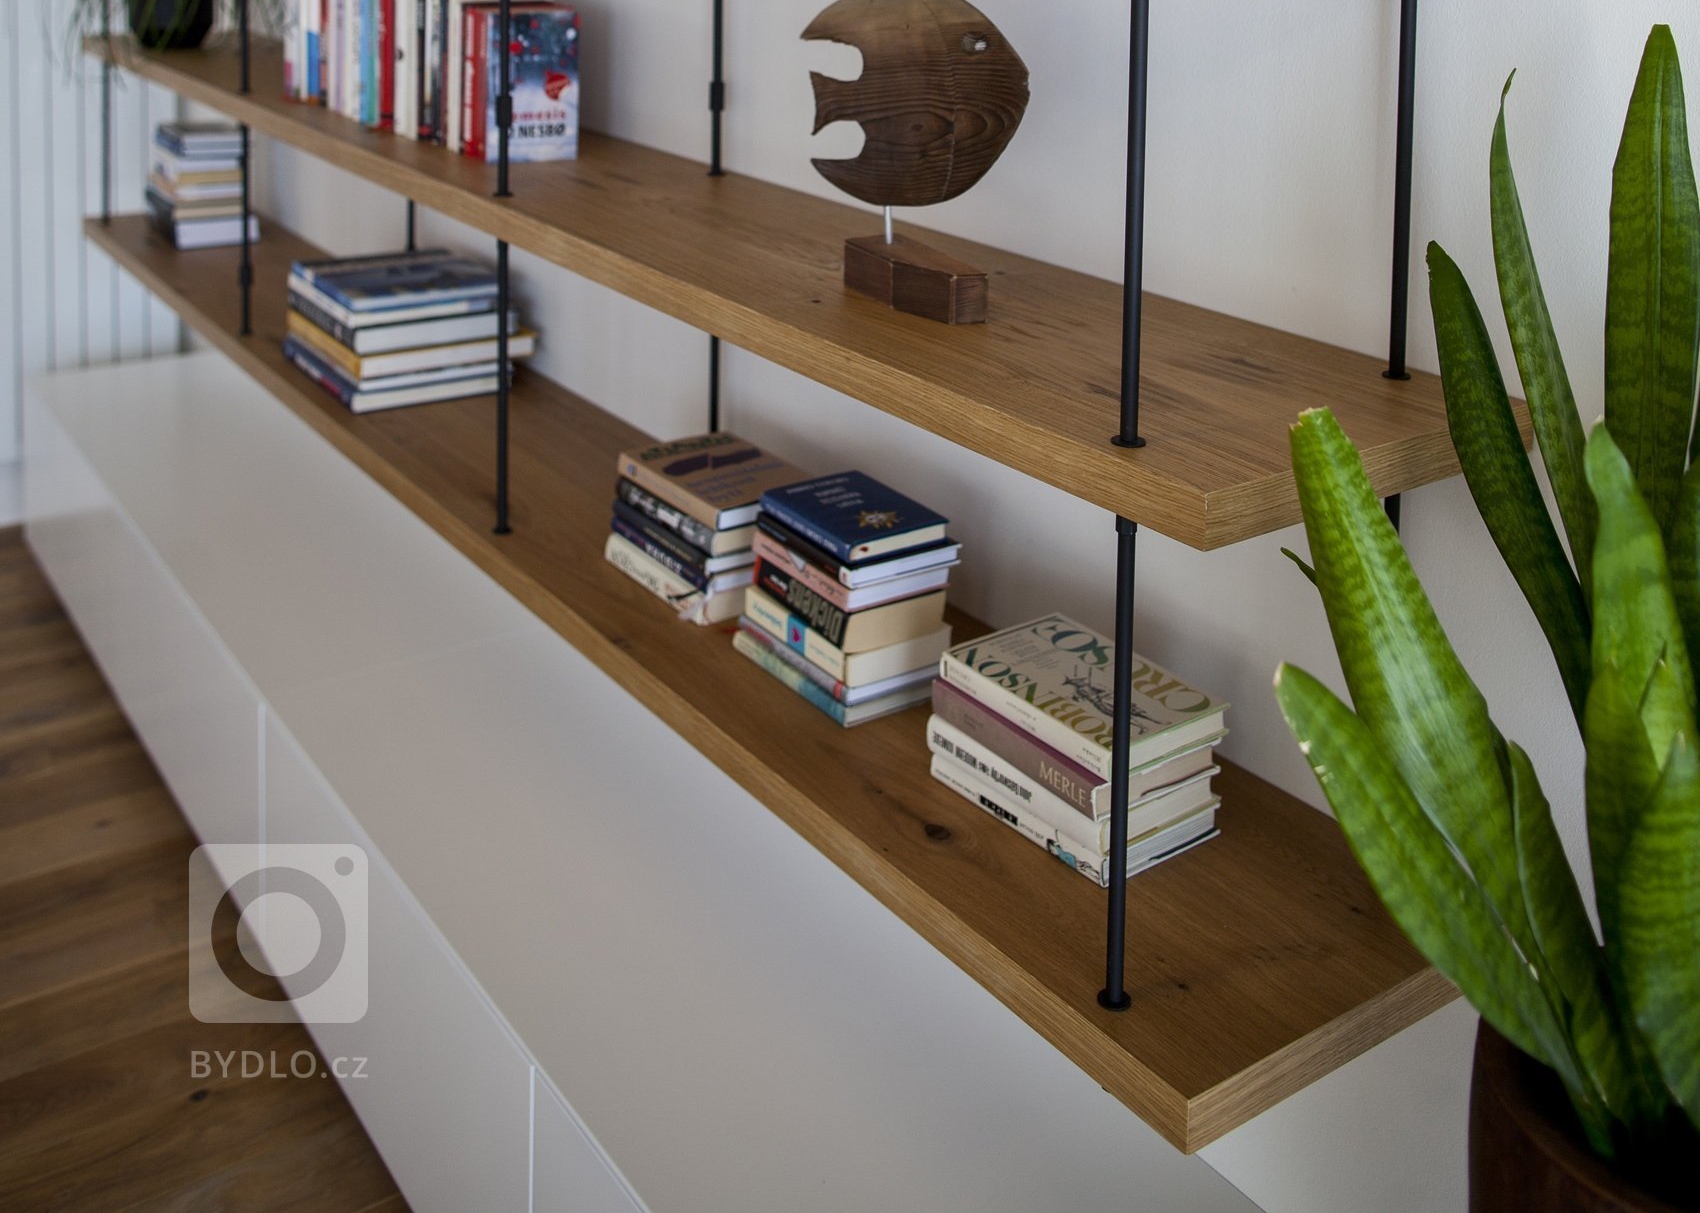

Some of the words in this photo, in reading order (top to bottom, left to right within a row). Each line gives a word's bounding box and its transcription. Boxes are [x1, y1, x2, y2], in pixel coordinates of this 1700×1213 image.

[511, 109, 566, 122] emesis
[518, 123, 566, 138] NESBØ
[1039, 760, 1087, 808] MERLE
